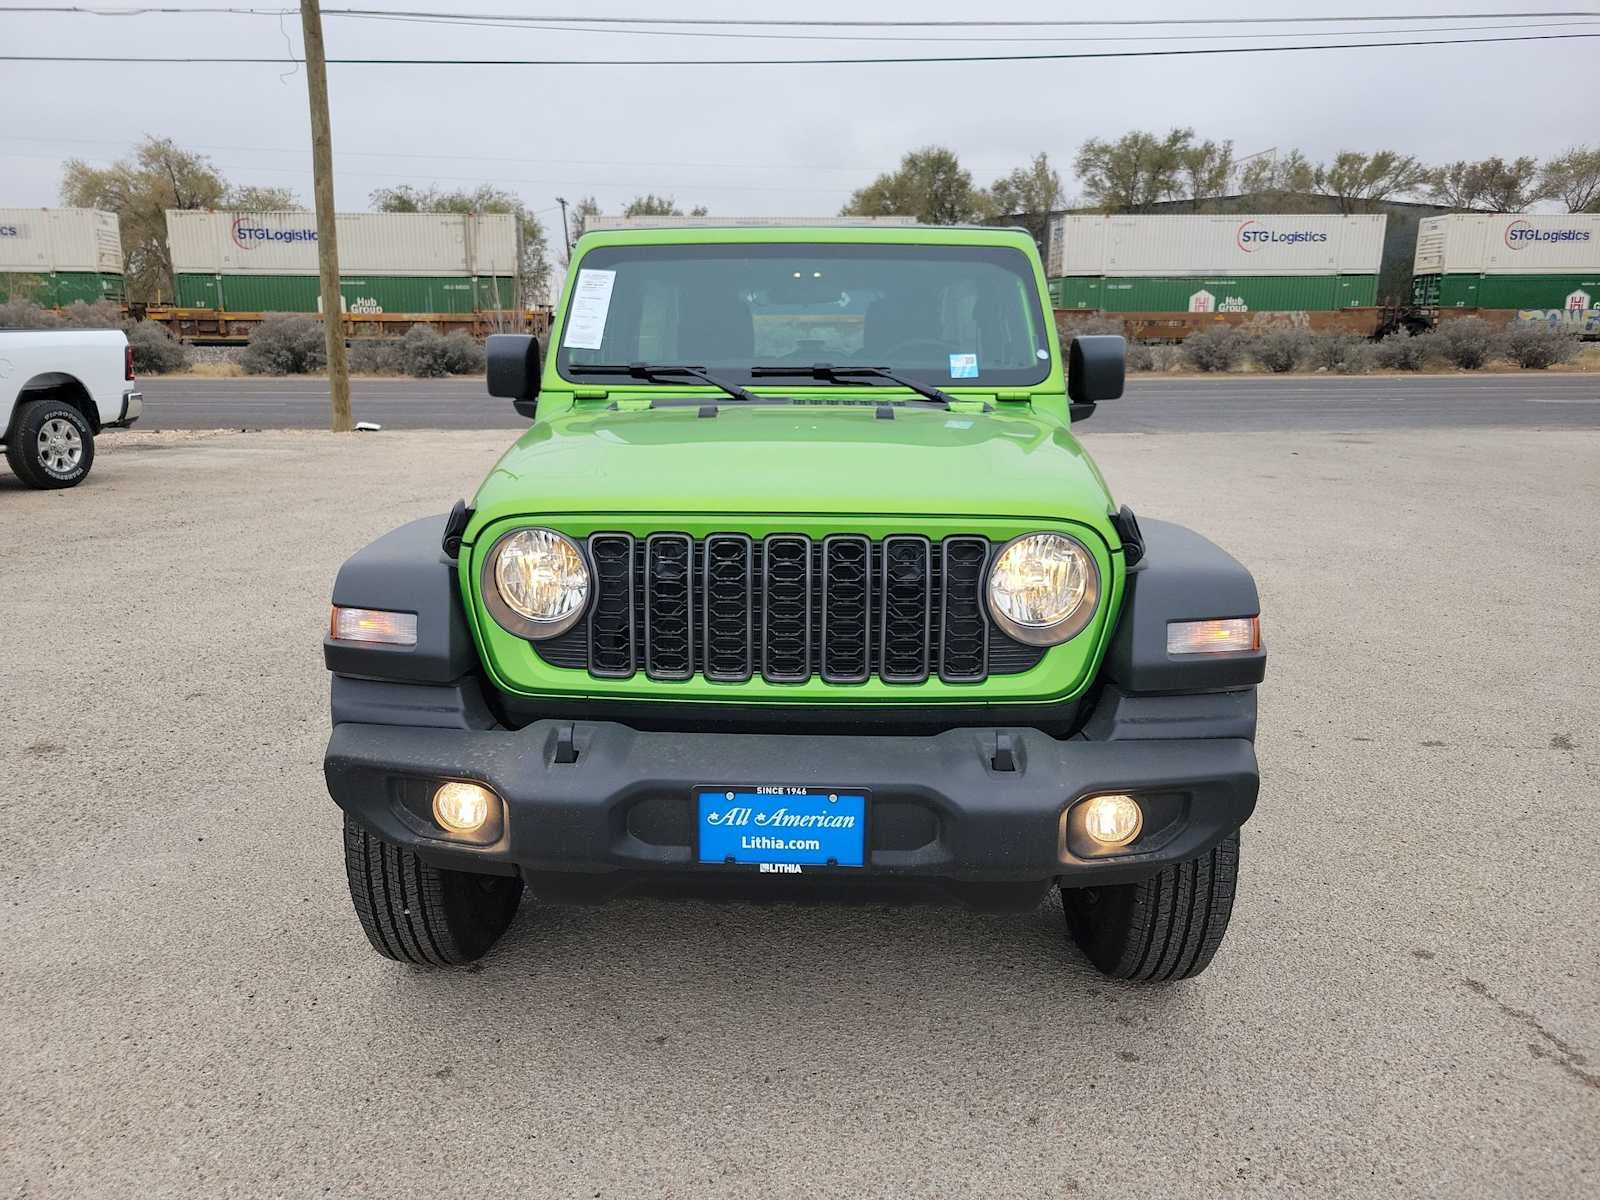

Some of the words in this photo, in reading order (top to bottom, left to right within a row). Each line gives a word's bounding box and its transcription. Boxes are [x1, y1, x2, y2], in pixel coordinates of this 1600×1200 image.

[266, 228, 319, 243] Logistic
[1242, 231, 1270, 242] STG
[1271, 231, 1327, 244] Logistics
[357, 296, 377, 306] Hub
[1225, 296, 1244, 305] Hub
[1218, 303, 1248, 313] Group
[757, 787, 784, 795] SINCE
[786, 787, 807, 796] 1946
[707, 807, 752, 826] All
[754, 808, 855, 828] American
[741, 836, 820, 850] Lithia.com
[769, 863, 802, 874] LITHIA
